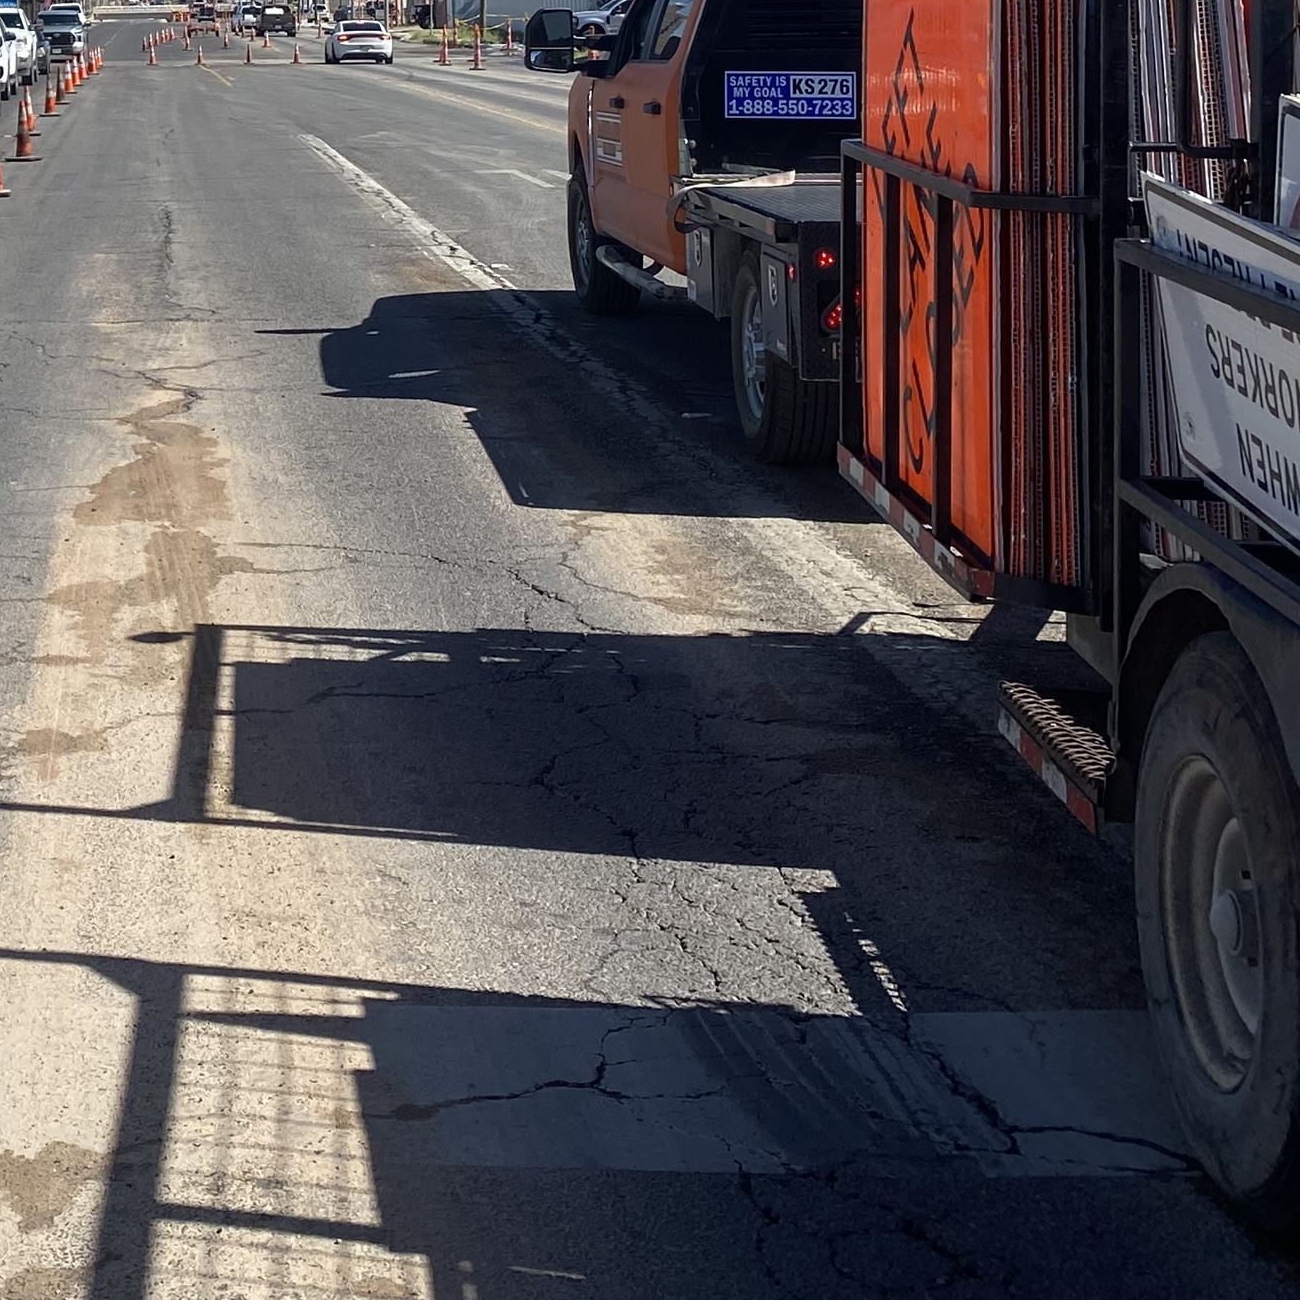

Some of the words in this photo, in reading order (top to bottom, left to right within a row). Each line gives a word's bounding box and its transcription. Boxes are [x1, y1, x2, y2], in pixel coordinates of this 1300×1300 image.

[729, 75, 773, 87] SAFETY
[775, 75, 787, 87] IS
[792, 77, 815, 96] KS
[817, 78, 850, 96] 276
[733, 87, 751, 98] MY
[753, 87, 784, 98] GOAL
[728, 99, 853, 115] 1-888-550-7233
[1205, 324, 1300, 434] ORKERS
